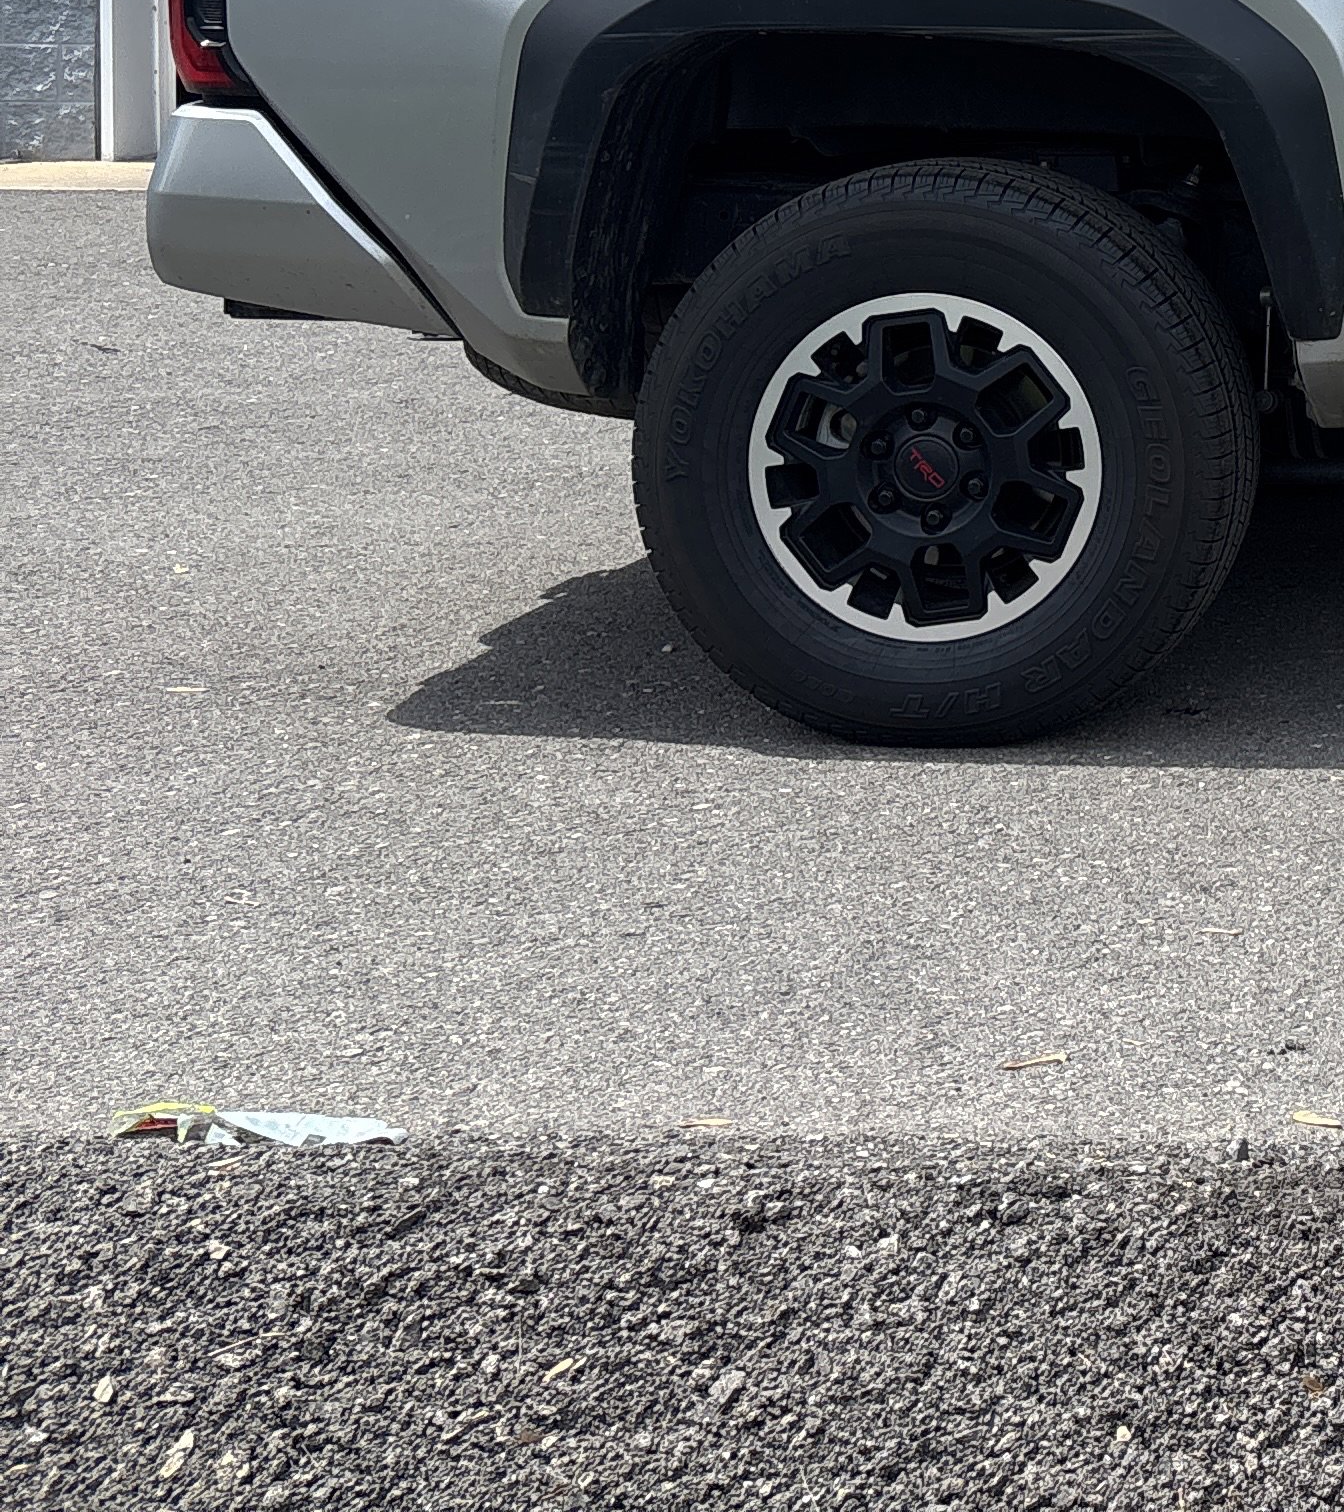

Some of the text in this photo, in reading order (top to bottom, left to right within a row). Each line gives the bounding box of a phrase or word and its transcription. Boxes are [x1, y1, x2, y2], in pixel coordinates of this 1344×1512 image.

[665, 232, 851, 483] YOKOHAMA
[910, 447, 945, 489] TRD
[1020, 366, 1172, 694] GEOLANDAR
